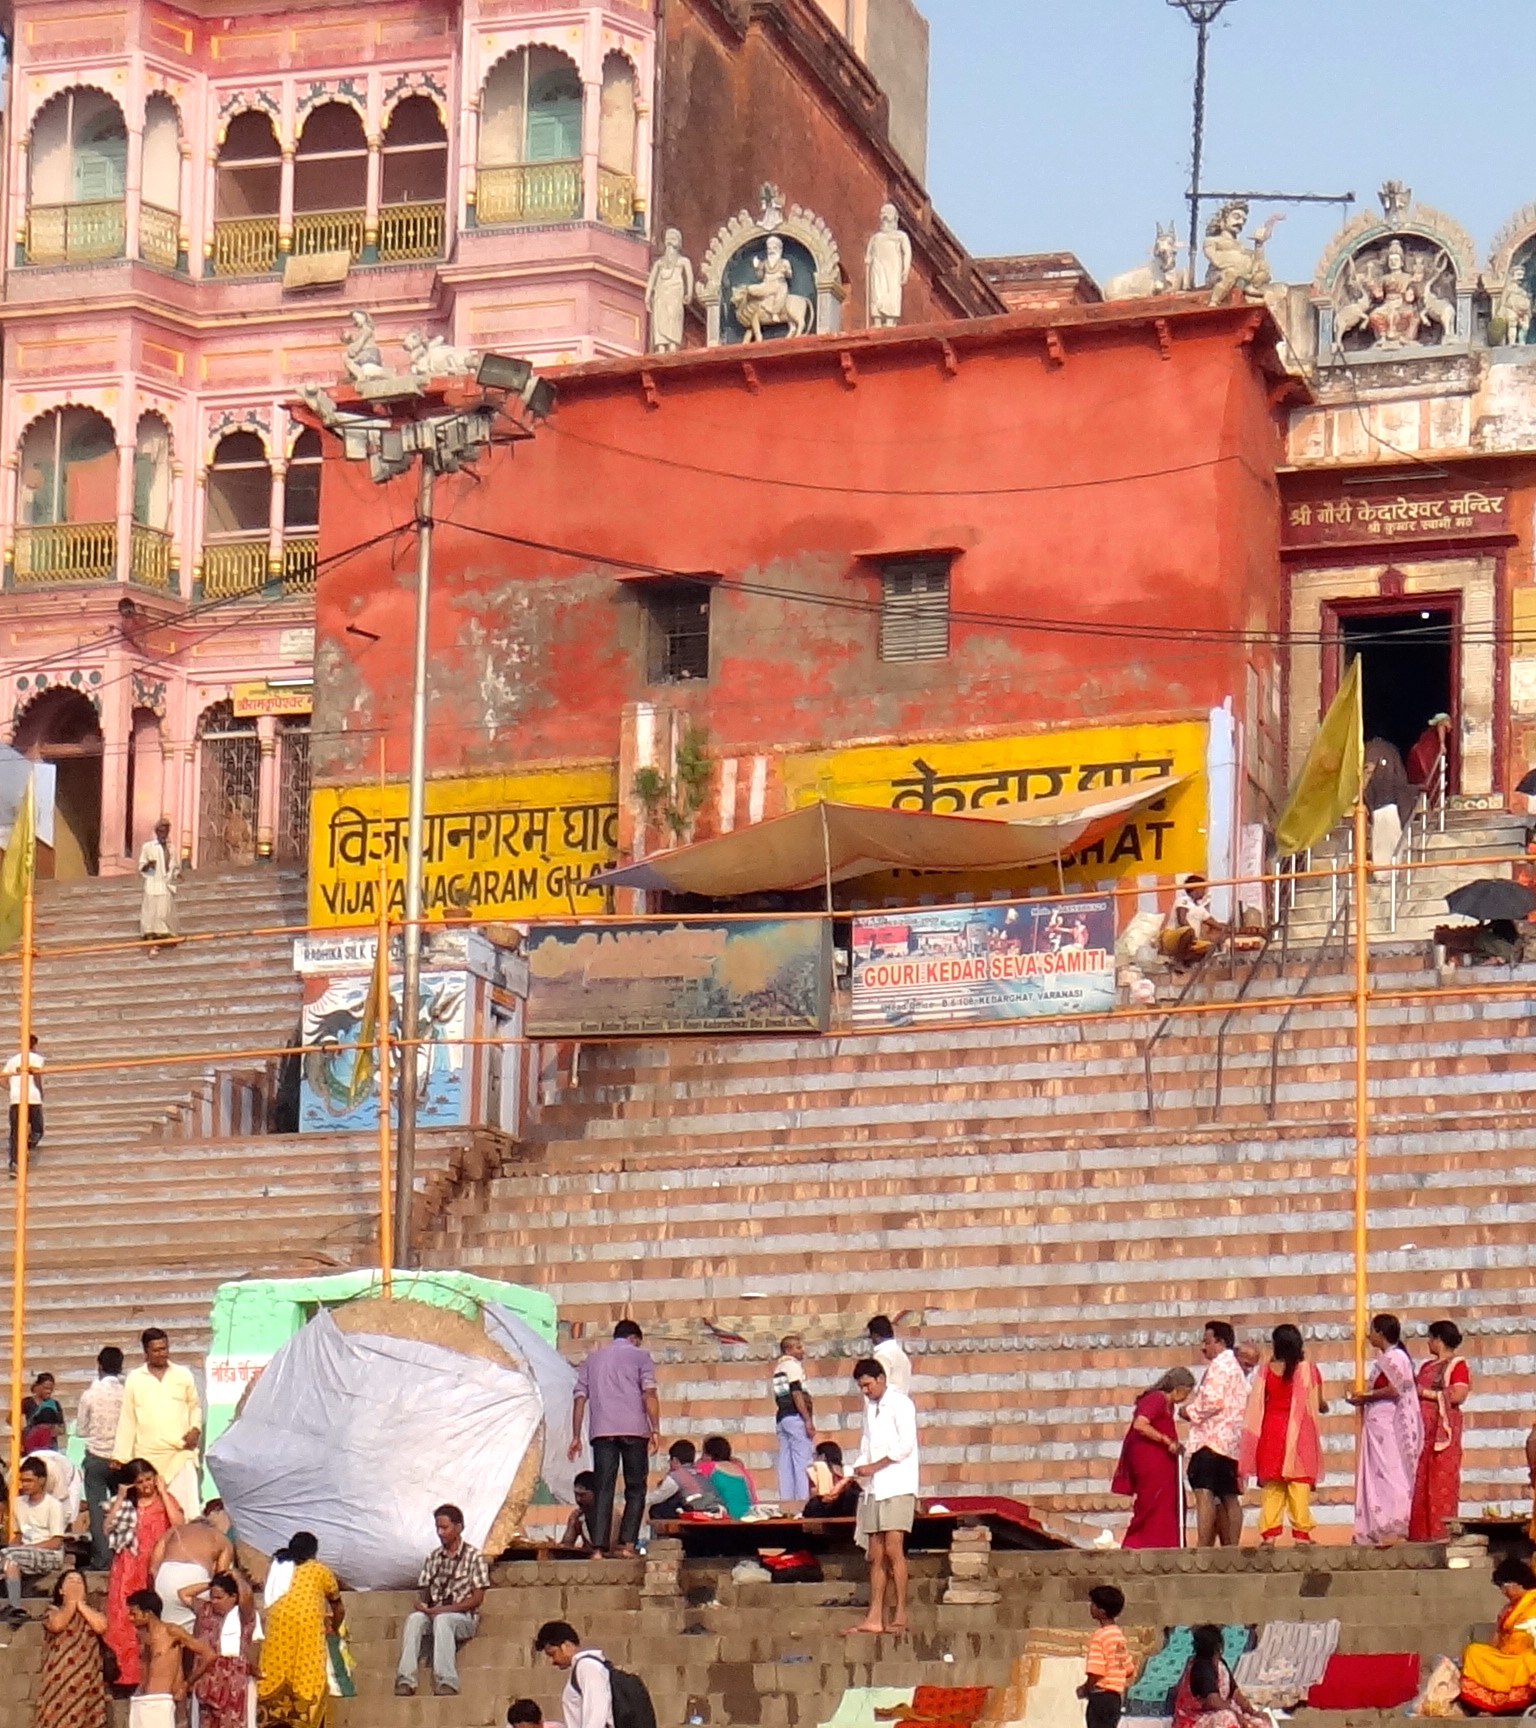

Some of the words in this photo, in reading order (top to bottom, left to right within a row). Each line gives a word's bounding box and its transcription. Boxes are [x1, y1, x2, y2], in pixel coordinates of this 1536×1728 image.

[1289, 504, 1311, 526] श्री
[1317, 501, 1352, 524] गौरी
[1357, 496, 1445, 521] केदारेश्वर
[1449, 492, 1505, 515] मन्दिर
[328, 806, 556, 869] विजयानगरम्
[1052, 821, 1175, 868] HAT
[864, 964, 920, 987] GOURI
[927, 959, 986, 983] KEDAR
[992, 954, 1037, 978] SEVA
[1044, 950, 1105, 974] SAMITI
[1037, 989, 1084, 1001] VARANASI
